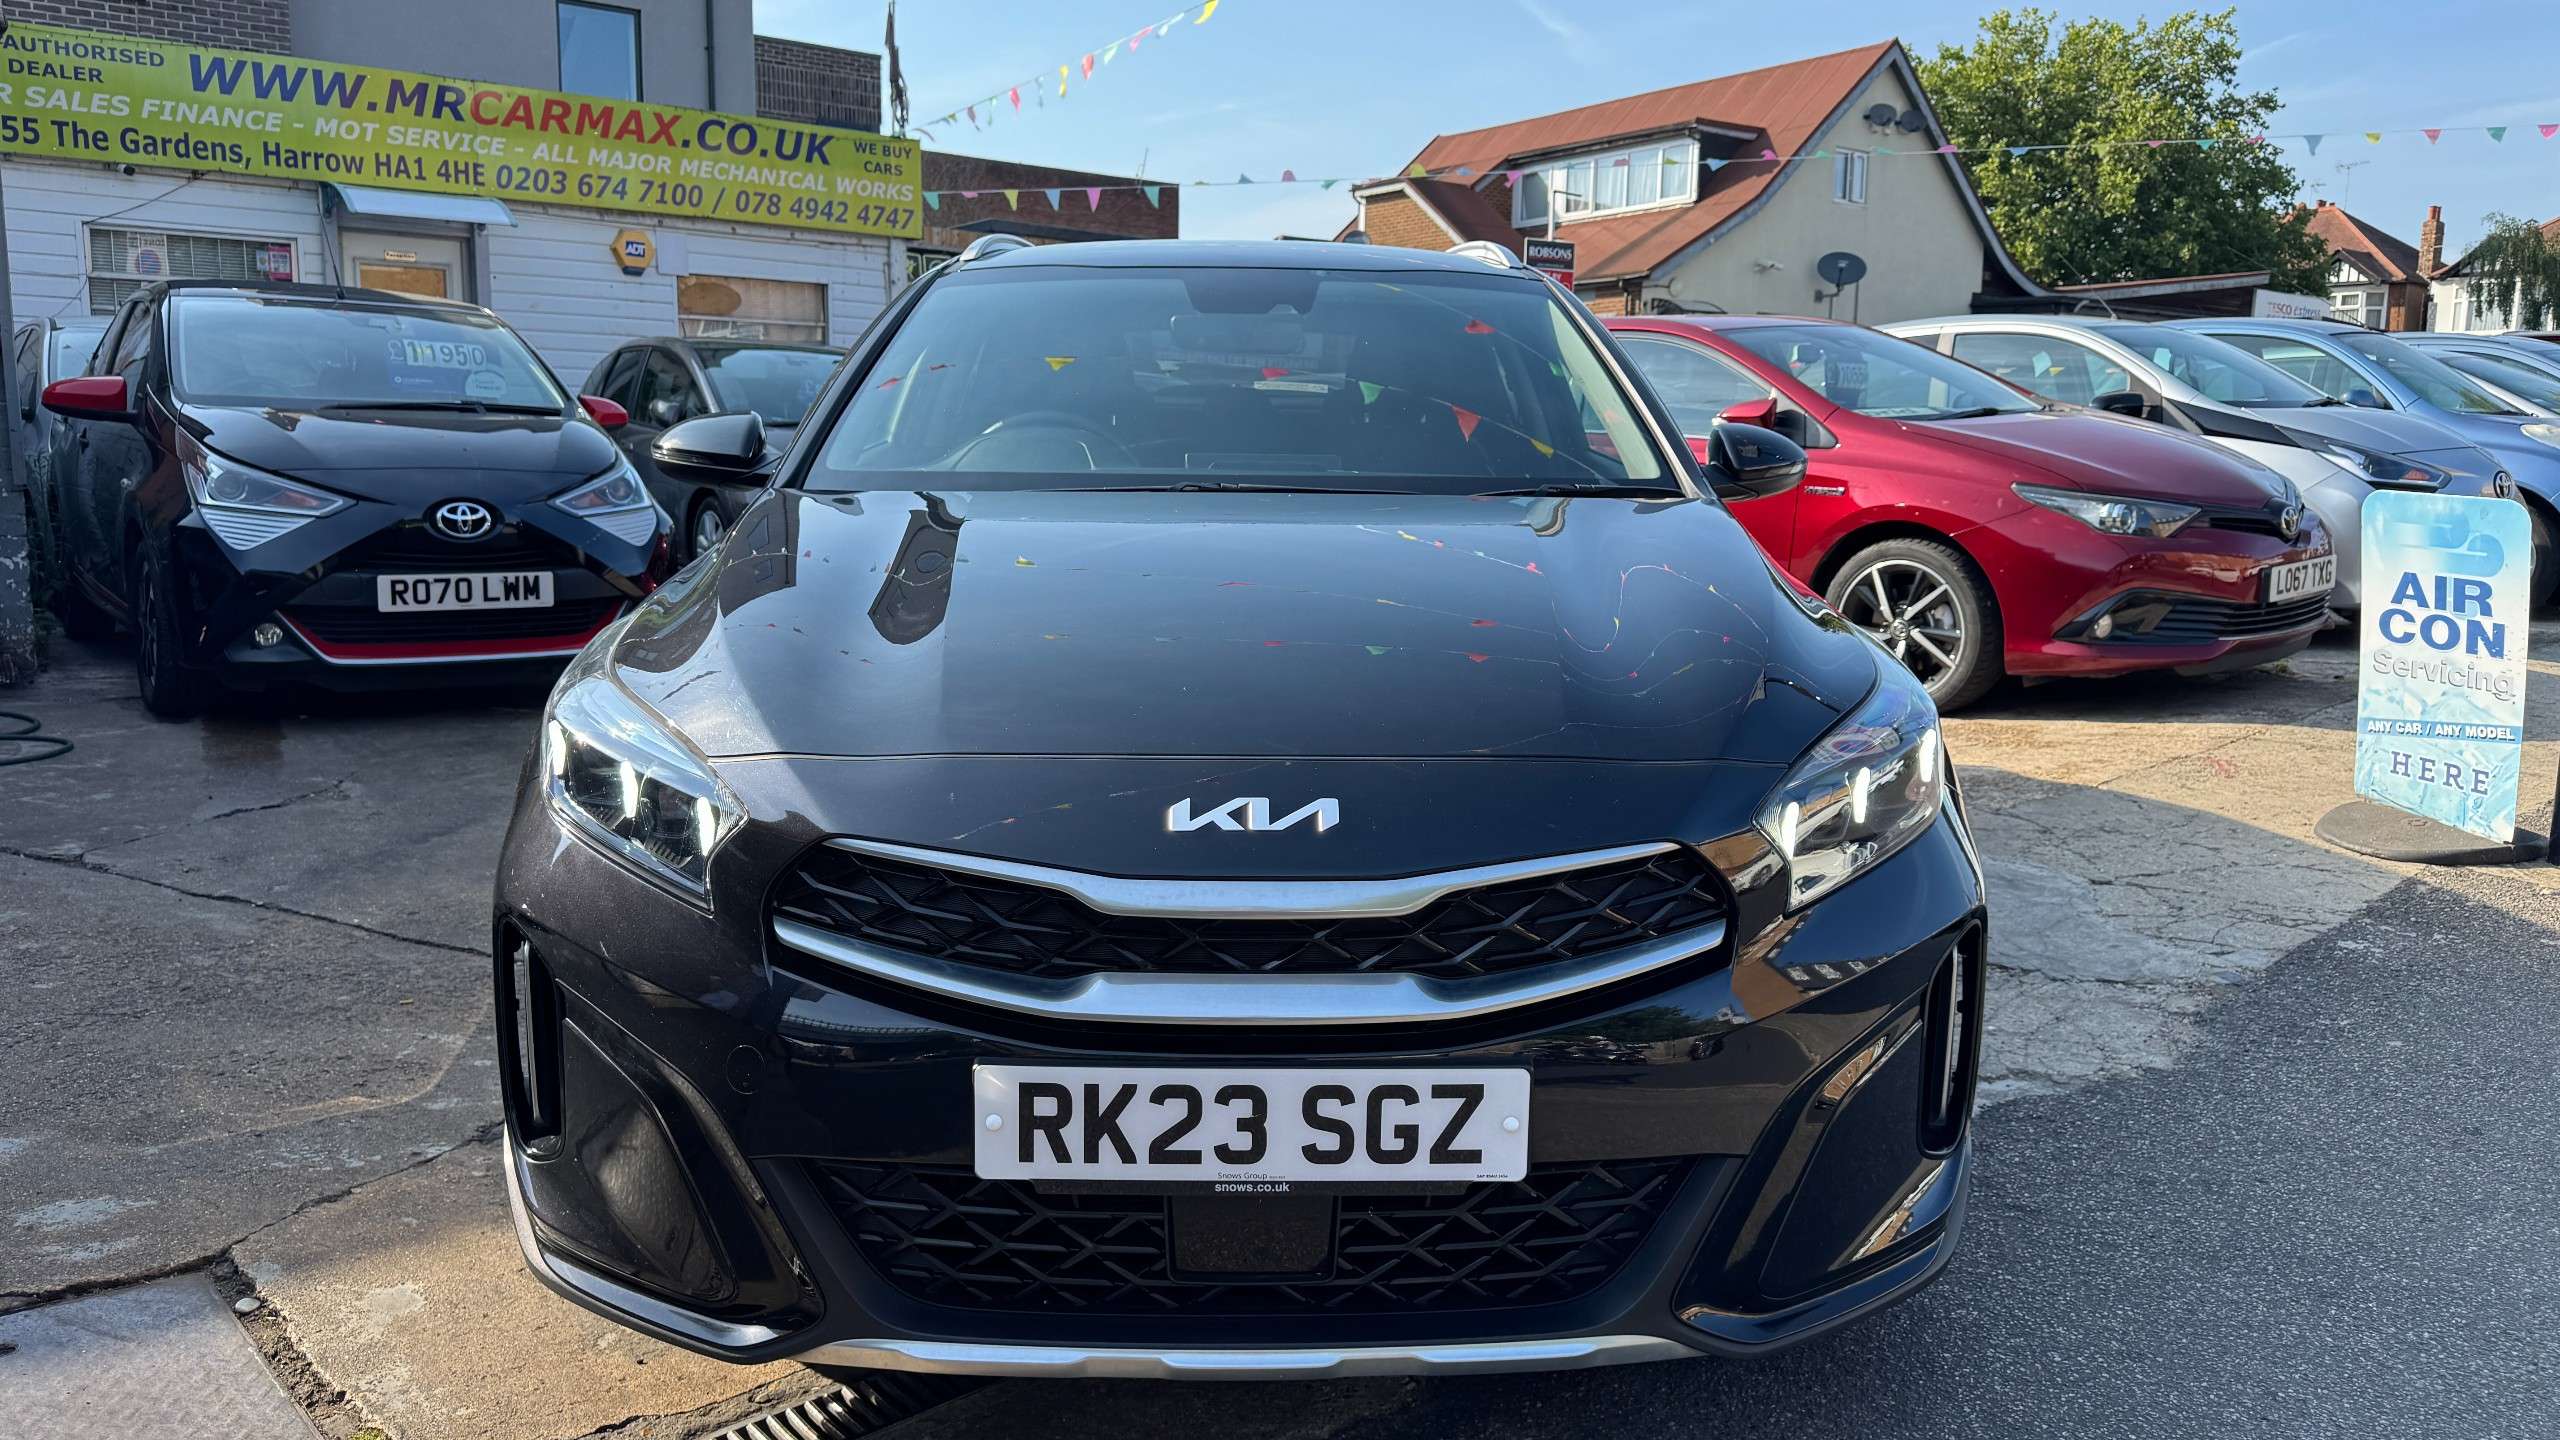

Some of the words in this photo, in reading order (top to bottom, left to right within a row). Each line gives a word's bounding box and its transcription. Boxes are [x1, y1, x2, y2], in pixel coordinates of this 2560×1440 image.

[3, 34, 165, 67] AUTHORISED
[8, 58, 104, 84] DEALER
[188, 53, 836, 166] WWW.MRCARMAX.CO.UK
[24, 85, 131, 117] SALES
[141, 98, 284, 132] FINANCE
[314, 117, 380, 142] MOT
[386, 125, 507, 156] SERVICE
[532, 142, 579, 165] ALL
[587, 148, 672, 174] MAJOR
[680, 158, 828, 192] MECHANICAL
[835, 175, 915, 202] WORKS
[853, 140, 878, 156] WE
[882, 142, 913, 160] BUY
[1, 114, 41, 145] 55
[50, 119, 110, 151] The
[119, 126, 251, 170] Gardens,
[262, 140, 365, 176] Harrow
[374, 152, 427, 181] HA1
[437, 159, 486, 187] 4HE
[496, 164, 568, 195] 0203
[577, 173, 628, 200] 674
[638, 179, 704, 208] 7100
[735, 190, 782, 216] 078
[789, 197, 849, 224] 4942
[857, 203, 915, 230] 4747
[863, 160, 904, 177] CARS
[625, 240, 645, 256] ADT
[1528, 245, 1573, 260] ROBSONS
[390, 577, 473, 606] RO70
[482, 575, 541, 603] LWM
[2276, 564, 2309, 596] LO67
[2312, 559, 2332, 587] TXG
[2390, 571, 2494, 618] AIR
[2378, 608, 2506, 660] CON
[2372, 647, 2516, 701] Servicing
[2367, 720, 2393, 733] ANY
[2395, 721, 2423, 735] CAR
[2434, 723, 2463, 738] ANY
[2465, 725, 2516, 741] MODEL
[2389, 750, 2490, 796] HERE
[1166, 797, 1341, 832] KIA
[1017, 1081, 1269, 1165] RK23
[1300, 1083, 1486, 1165] SGZ
[1214, 1181, 1290, 1192] snows.co.uk
[1217, 1171, 1242, 1180] Snows
[1243, 1171, 1268, 1181] Group
